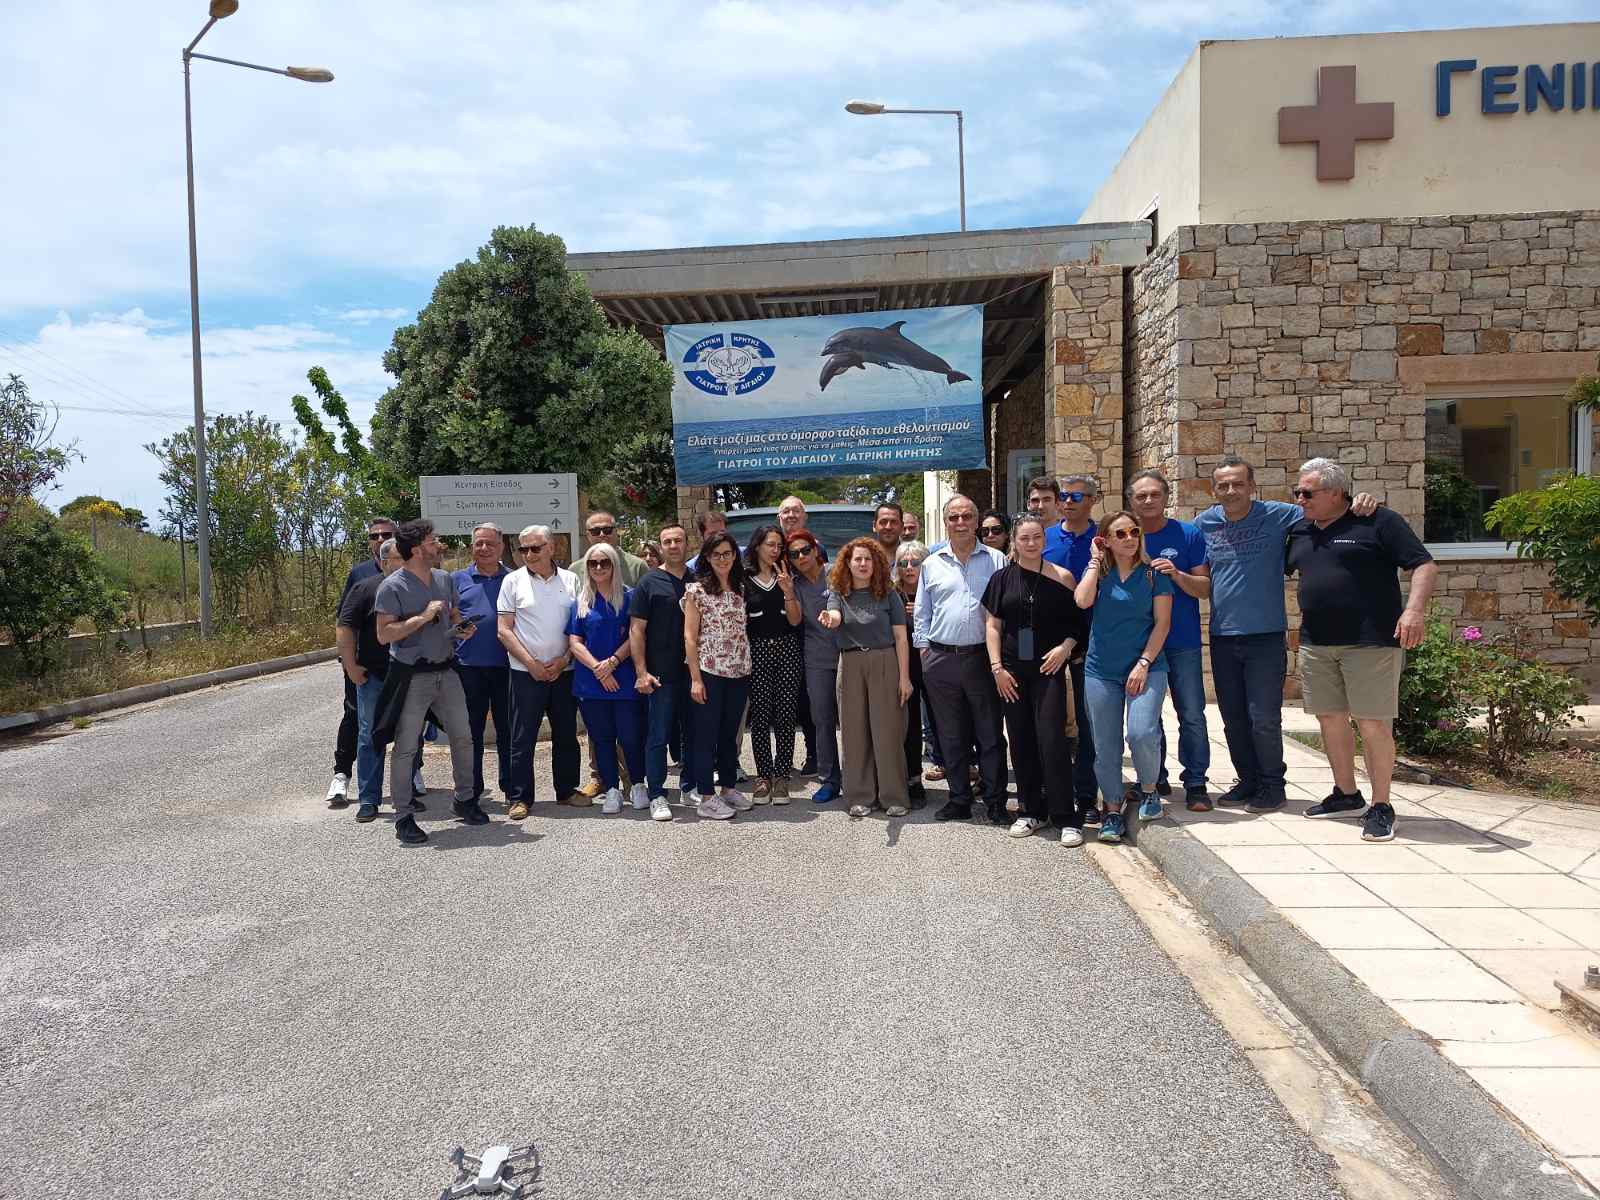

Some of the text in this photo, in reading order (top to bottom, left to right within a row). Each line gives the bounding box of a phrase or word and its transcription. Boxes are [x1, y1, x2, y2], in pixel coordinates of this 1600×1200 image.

[745, 434, 767, 446] μας
[768, 432, 788, 442] στο
[790, 428, 835, 443] όμορφο
[872, 426, 890, 435] του
[893, 419, 970, 434] εθελοντισμού
[717, 458, 762, 469] ΓΙΑΤΡΟΙ
[766, 456, 788, 466] ΤΟΥ
[790, 454, 836, 465] ΑΙΓΑΙΟΥ
[846, 450, 891, 462] ΙΑΤΡΙΚΗ
[895, 447, 942, 459] ΚΡΗΤΗΣ
